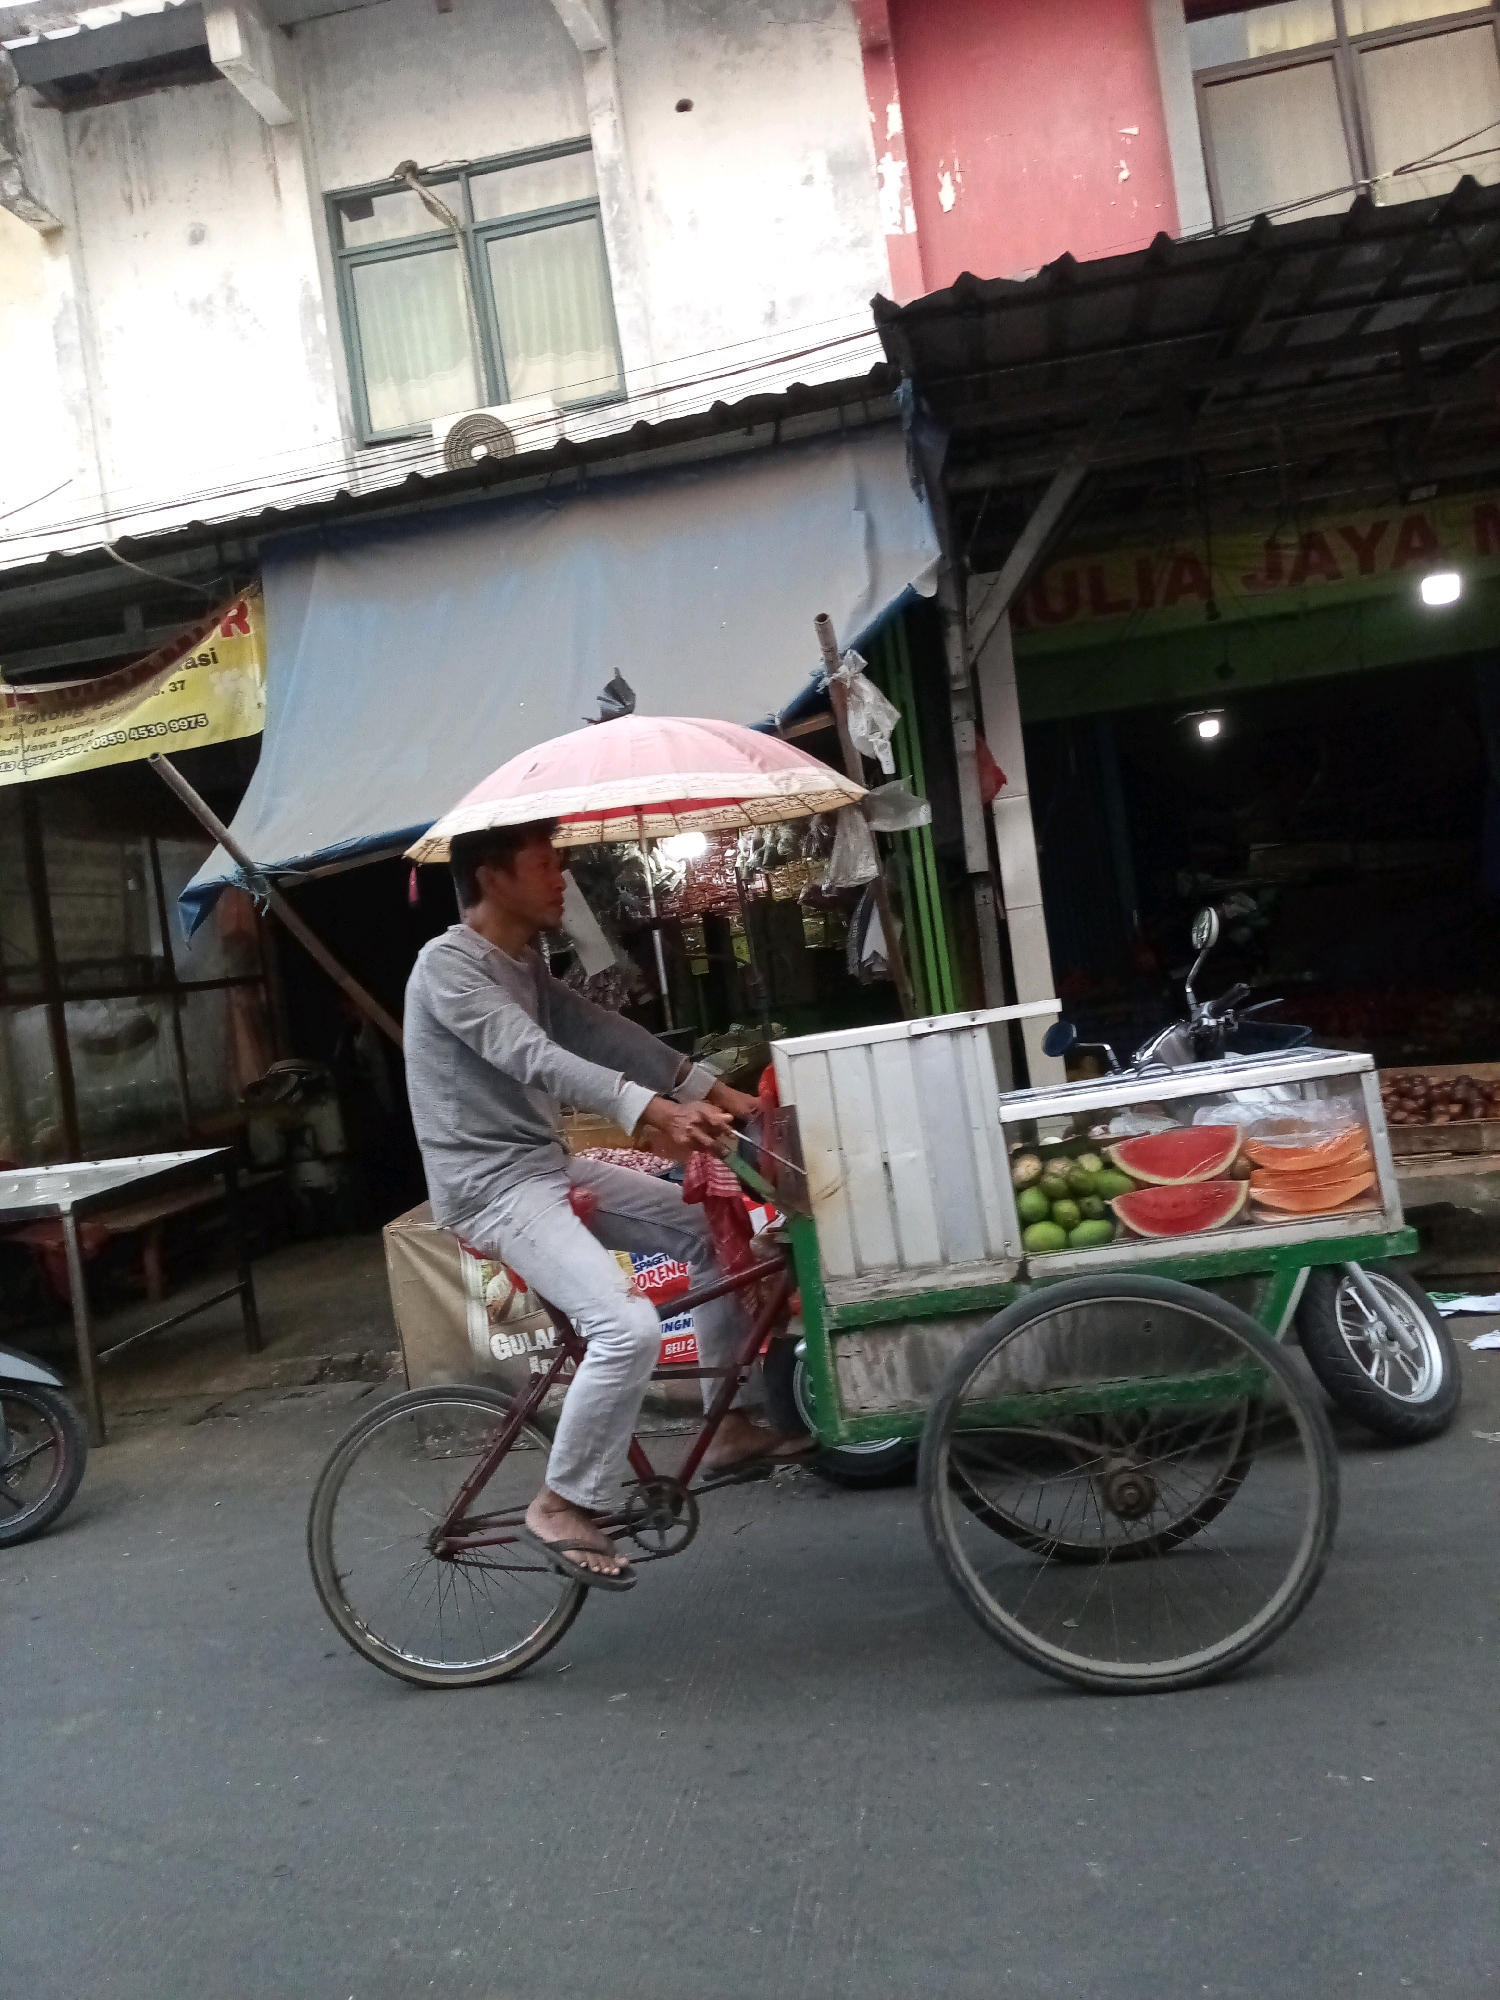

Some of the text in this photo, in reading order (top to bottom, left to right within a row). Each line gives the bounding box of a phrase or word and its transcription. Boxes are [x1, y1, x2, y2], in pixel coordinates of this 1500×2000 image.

[1241, 513, 1442, 590] JAYA
[168, 679, 187, 693] 37
[61, 729, 95, 745] Barat
[91, 731, 128, 751] 0859
[129, 719, 168, 741] 4536
[168, 712, 209, 734] 9975
[633, 1253, 670, 1273] SPAGET
[630, 1261, 689, 1289] ORENG
[664, 1341, 687, 1356] BELI
